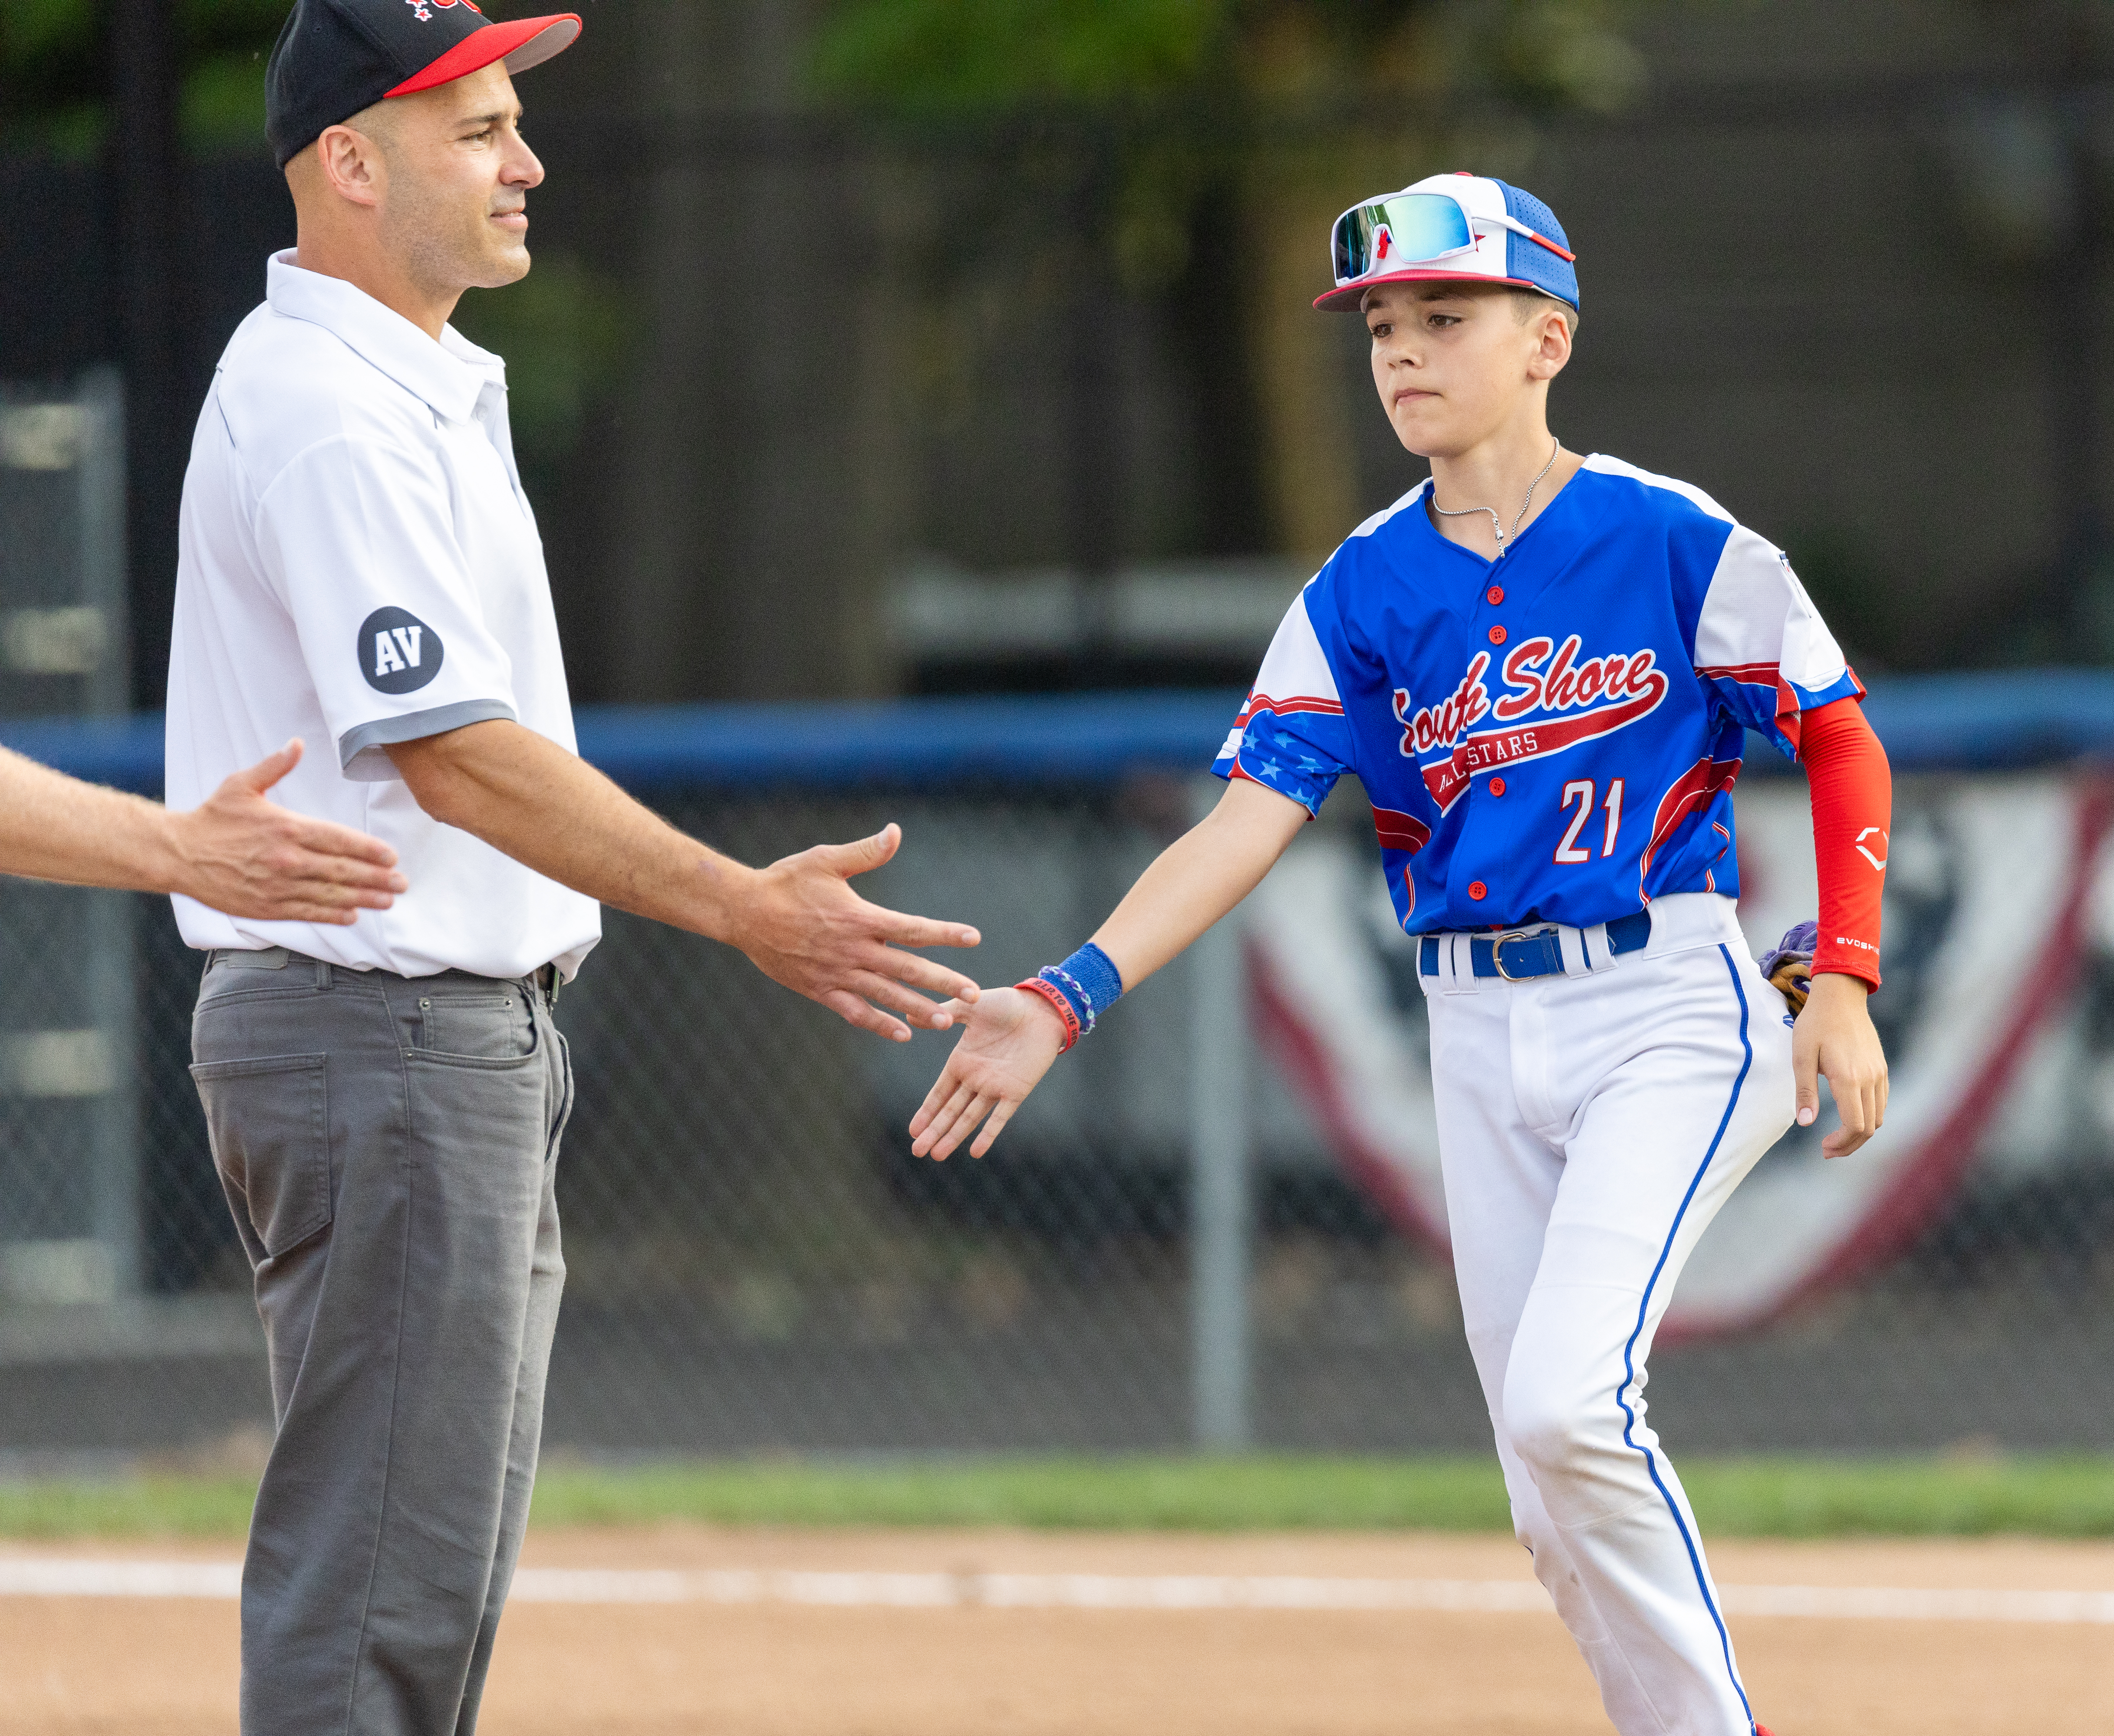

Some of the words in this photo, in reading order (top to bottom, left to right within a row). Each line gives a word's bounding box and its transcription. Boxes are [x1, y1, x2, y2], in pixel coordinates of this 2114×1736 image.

[375, 625, 422, 676] AV
[1392, 651, 1492, 758] South
[1492, 634, 1658, 720] Shore
[1438, 761, 1467, 792] ALL
[1467, 732, 1538, 766] STARS
[1552, 777, 1626, 865] 21
[1033, 980, 1056, 996] R.I.P.
[1054, 994, 1066, 1006] TO
[1064, 1007, 1077, 1026] THE
